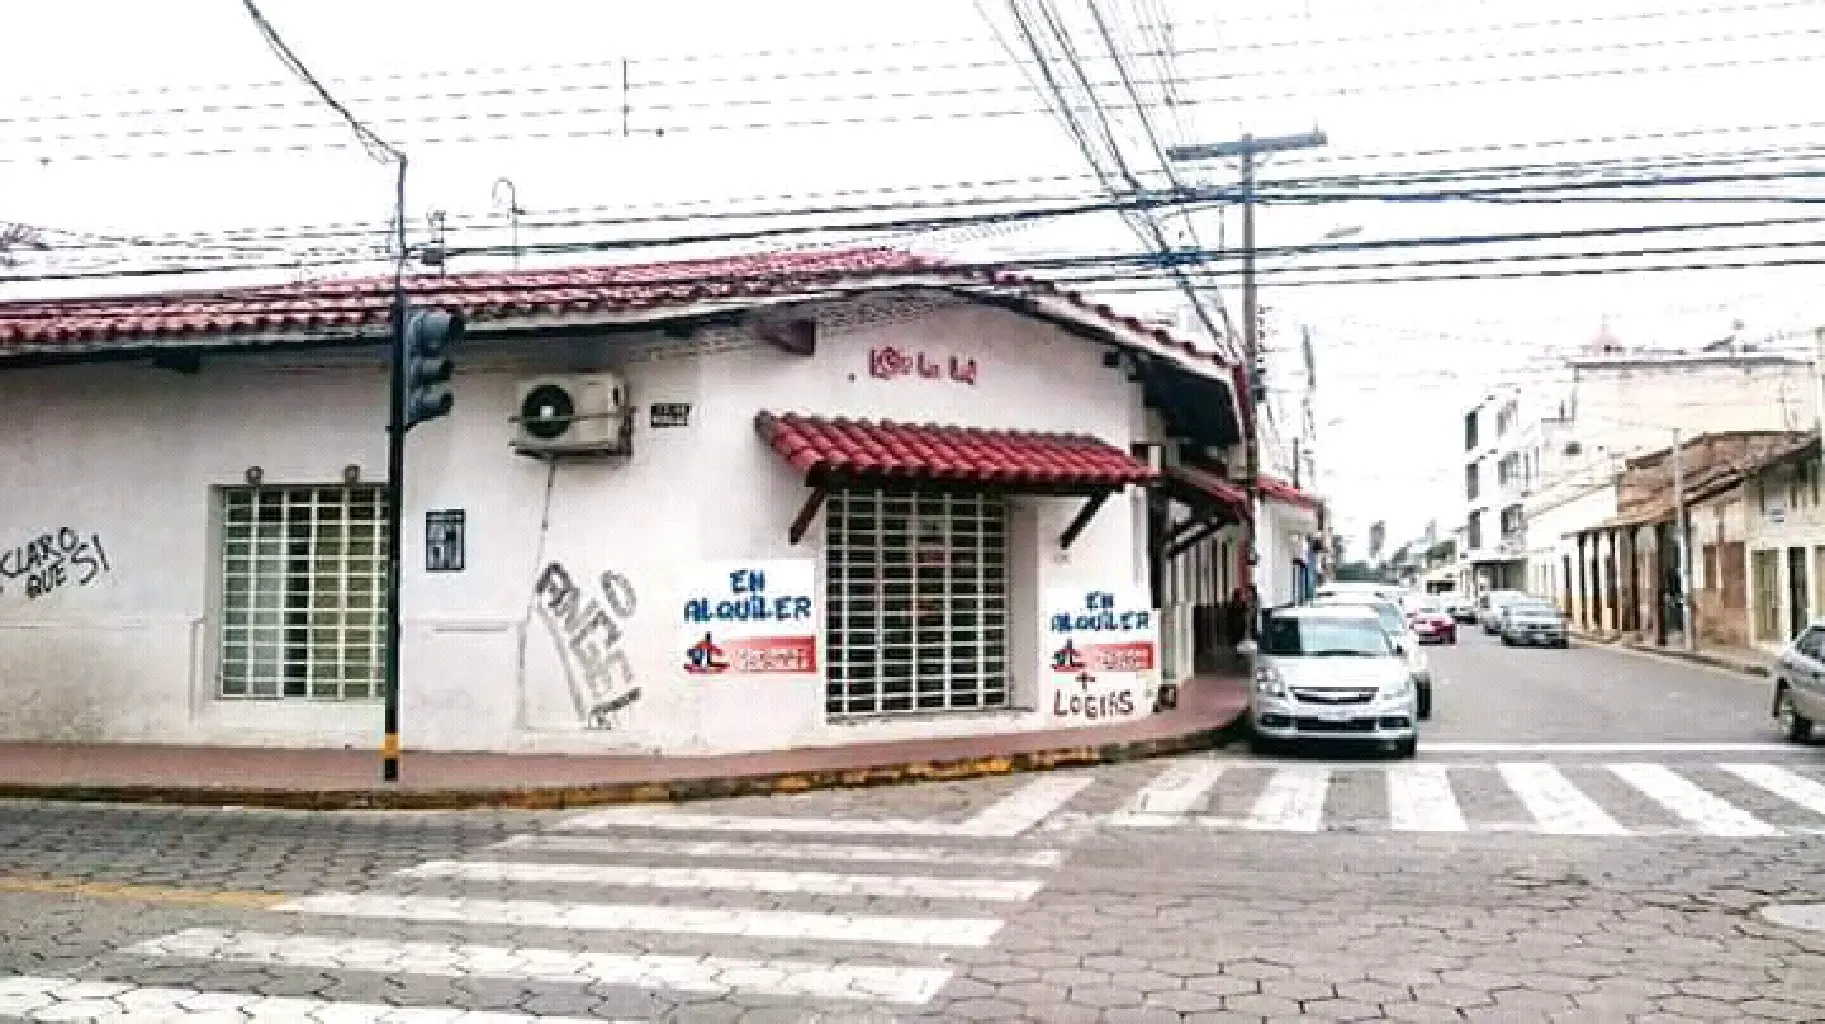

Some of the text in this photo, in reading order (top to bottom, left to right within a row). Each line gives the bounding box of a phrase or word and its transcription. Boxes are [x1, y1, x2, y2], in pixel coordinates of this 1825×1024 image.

[729, 568, 767, 594] EN
[683, 594, 813, 623] ALQUILER
[1085, 590, 1115, 611] EN
[1050, 610, 1150, 633] ALQUILER
